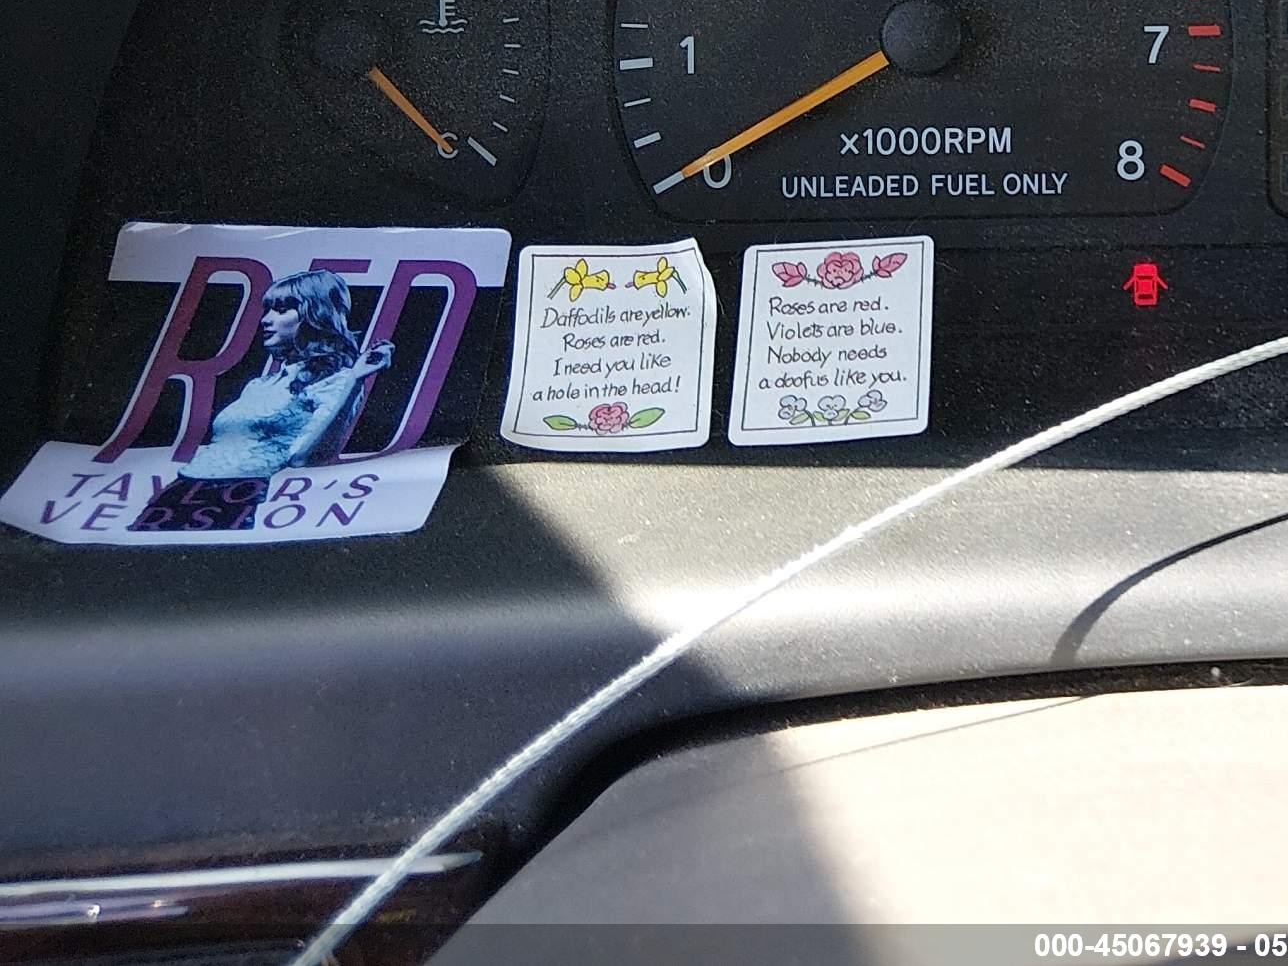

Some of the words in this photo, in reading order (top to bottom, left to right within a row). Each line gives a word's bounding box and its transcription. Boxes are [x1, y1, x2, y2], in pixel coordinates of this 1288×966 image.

[680, 37, 696, 74] 1
[1144, 26, 1169, 64] 7
[840, 127, 1012, 156] x1000RPM
[1116, 141, 1144, 181] 8
[782, 175, 918, 198] UNLEADED
[930, 174, 994, 197] FUEL
[1002, 173, 1067, 195] ONLY
[541, 305, 615, 328] Daffodils
[620, 310, 641, 321] are
[769, 297, 815, 316] Roses
[819, 300, 847, 314] are
[853, 297, 889, 312] red.
[563, 333, 605, 352] Roses
[610, 335, 633, 346] are
[637, 330, 665, 344] red.
[767, 321, 824, 340] Violets
[827, 324, 854, 336] are
[861, 318, 902, 335] blue.
[553, 358, 562, 376] I
[565, 358, 601, 375] need
[605, 359, 634, 378] you
[640, 354, 671, 369] like
[768, 346, 832, 368] Nobody
[839, 345, 887, 362] needs
[533, 391, 542, 401] a
[547, 383, 580, 400] hole
[584, 384, 600, 398] in
[602, 382, 627, 397] the
[632, 375, 680, 395] head!
[759, 378, 770, 389] a
[775, 370, 829, 389] doofus
[834, 368, 866, 387] like
[869, 371, 906, 388] you.
[40, 499, 365, 531] VERSION
